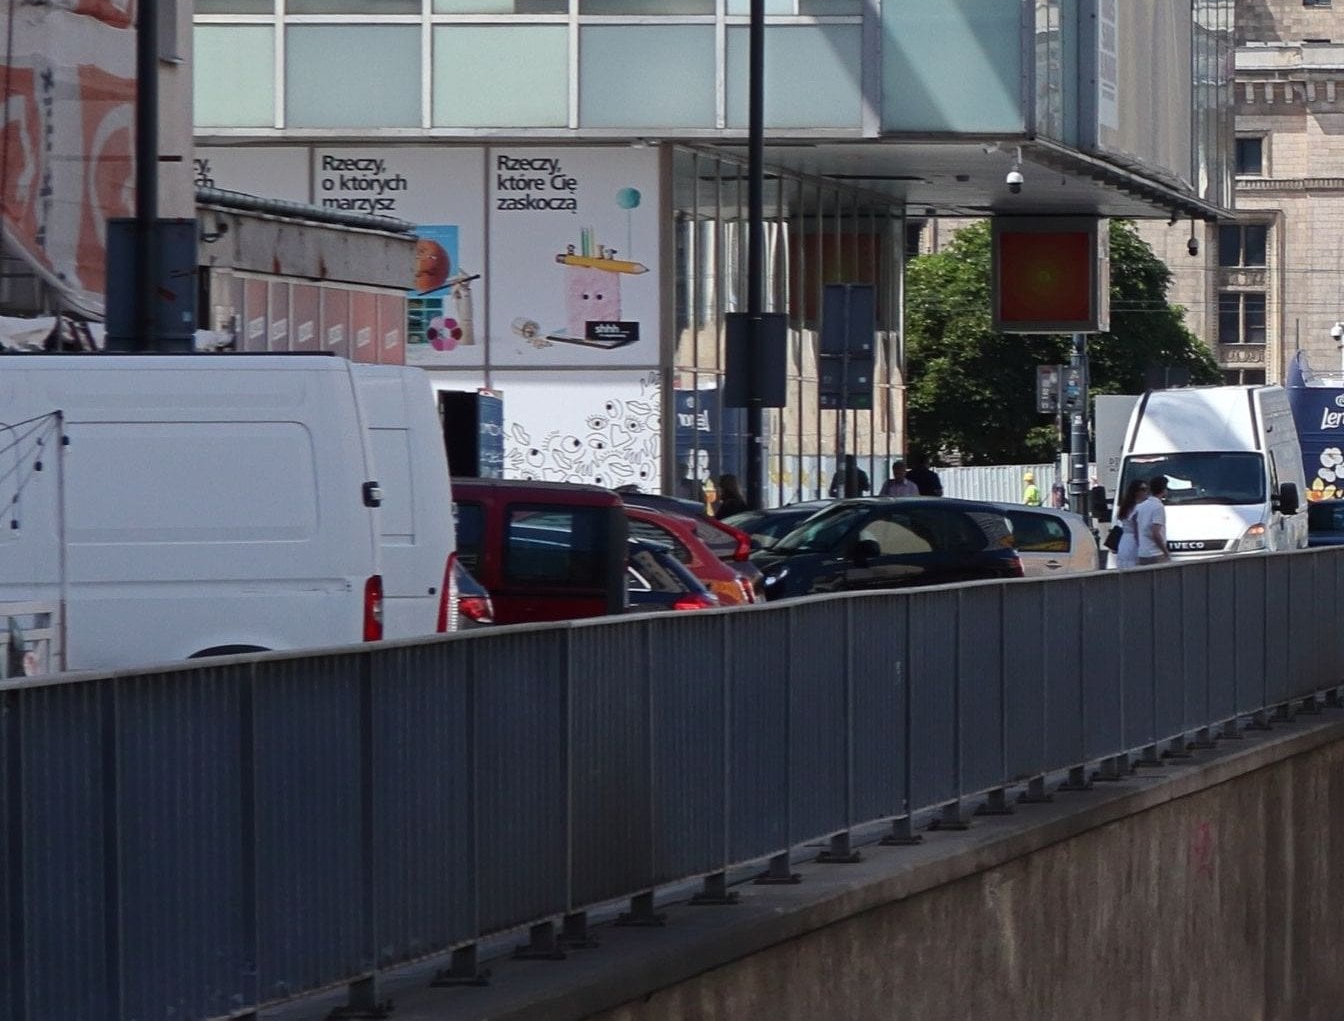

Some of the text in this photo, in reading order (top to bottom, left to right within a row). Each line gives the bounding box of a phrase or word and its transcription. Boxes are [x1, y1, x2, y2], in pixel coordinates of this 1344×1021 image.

[322, 155, 386, 176] Rzeczy,
[497, 155, 562, 175] Rzeczy,
[322, 174, 407, 195] o których
[497, 174, 578, 194] które Cię
[322, 197, 395, 214] marzysz
[497, 193, 577, 214] zaskoczą
